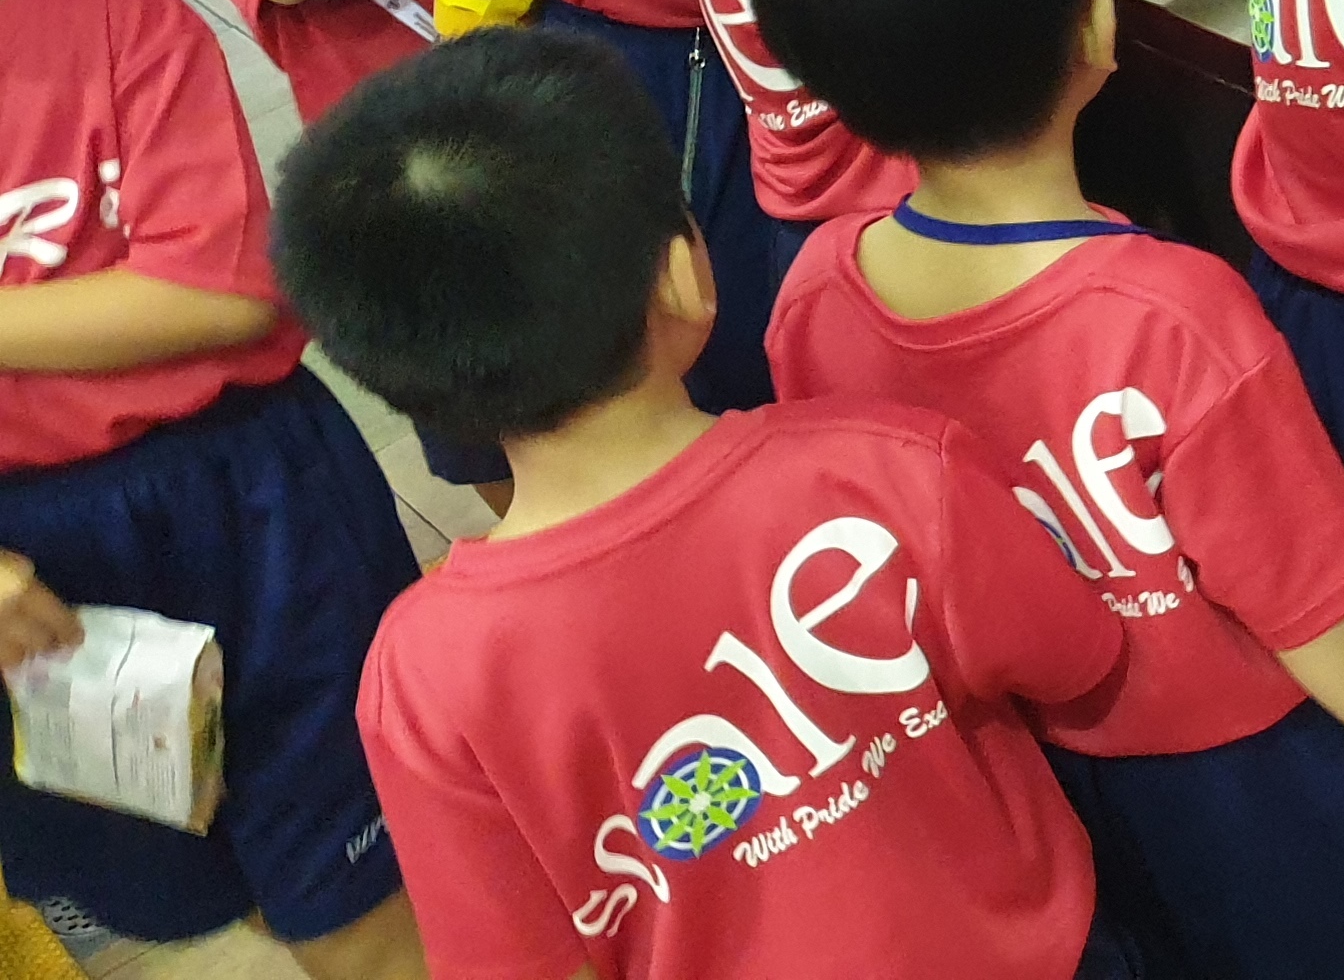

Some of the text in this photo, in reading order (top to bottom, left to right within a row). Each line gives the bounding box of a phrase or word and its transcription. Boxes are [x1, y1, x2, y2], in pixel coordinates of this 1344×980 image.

[1138, 589, 1180, 616] We
[733, 816, 799, 868] With
[792, 779, 870, 841] Pride
[862, 733, 897, 778] We
